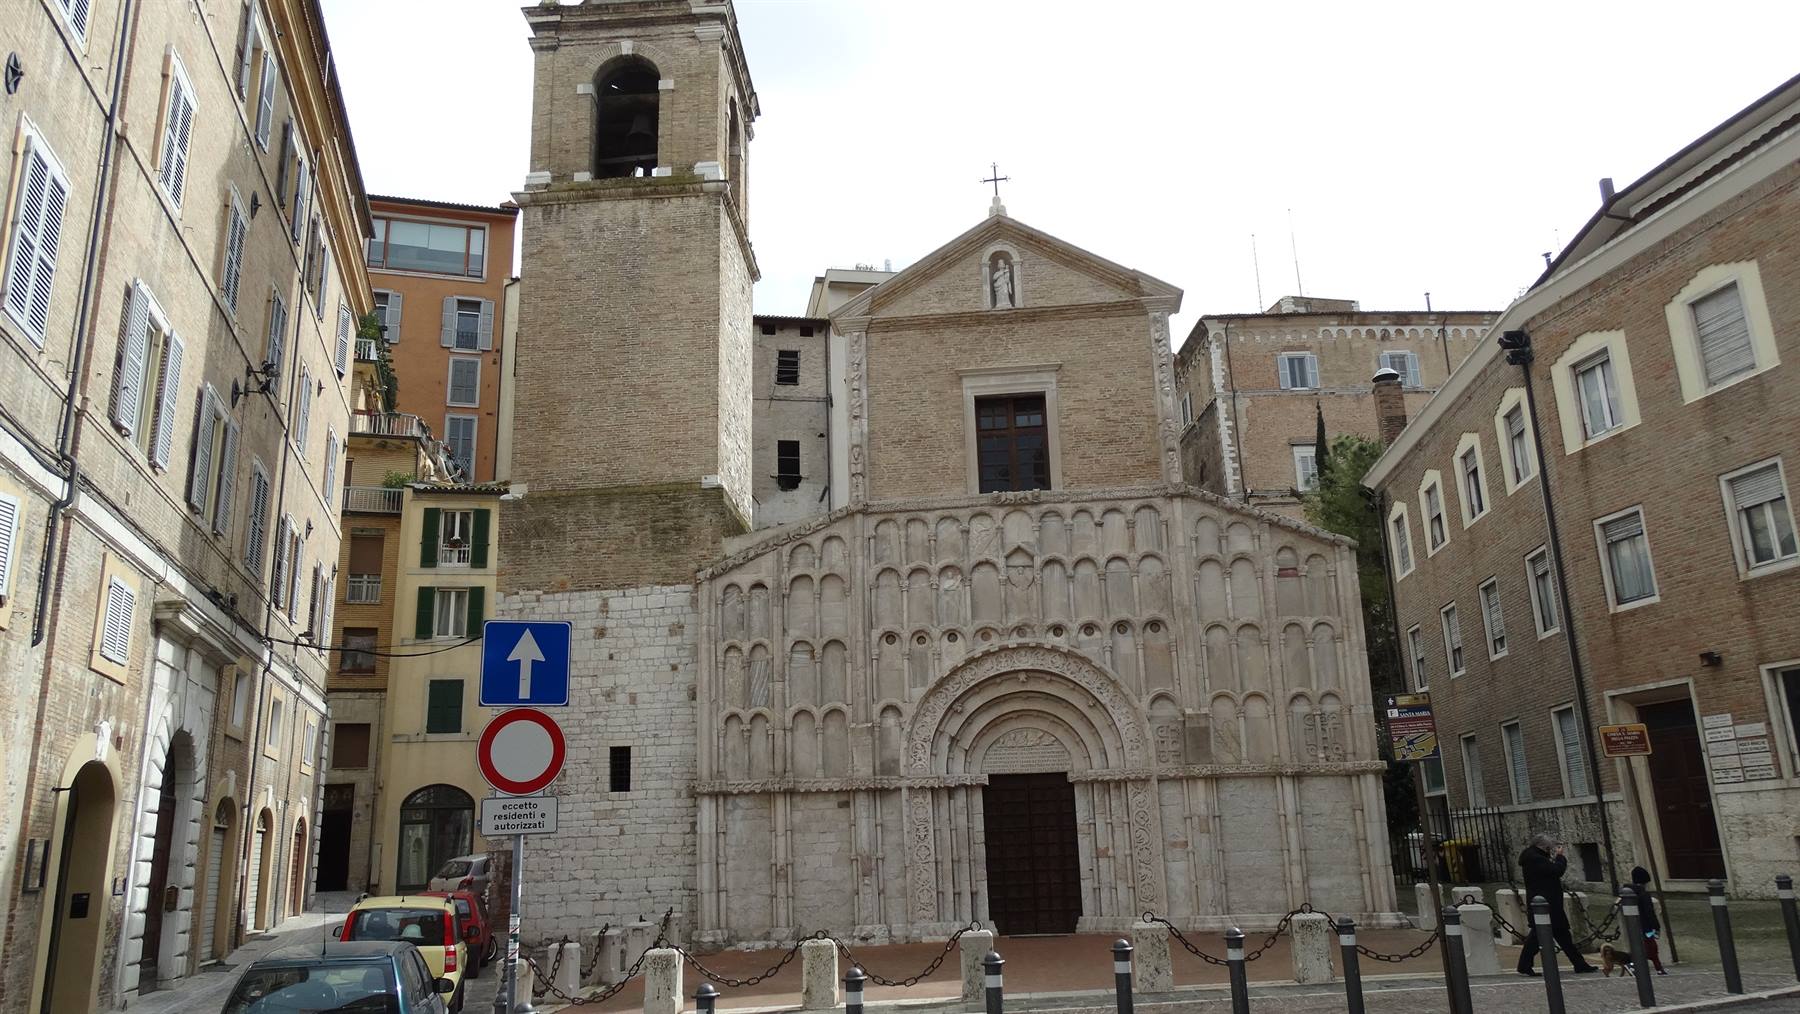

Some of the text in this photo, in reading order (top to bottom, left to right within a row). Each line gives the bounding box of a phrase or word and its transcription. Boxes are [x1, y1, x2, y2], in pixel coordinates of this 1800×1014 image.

[502, 801, 538, 810] eccetto
[493, 811, 536, 820] residenti
[494, 821, 545, 830] autorizzati
